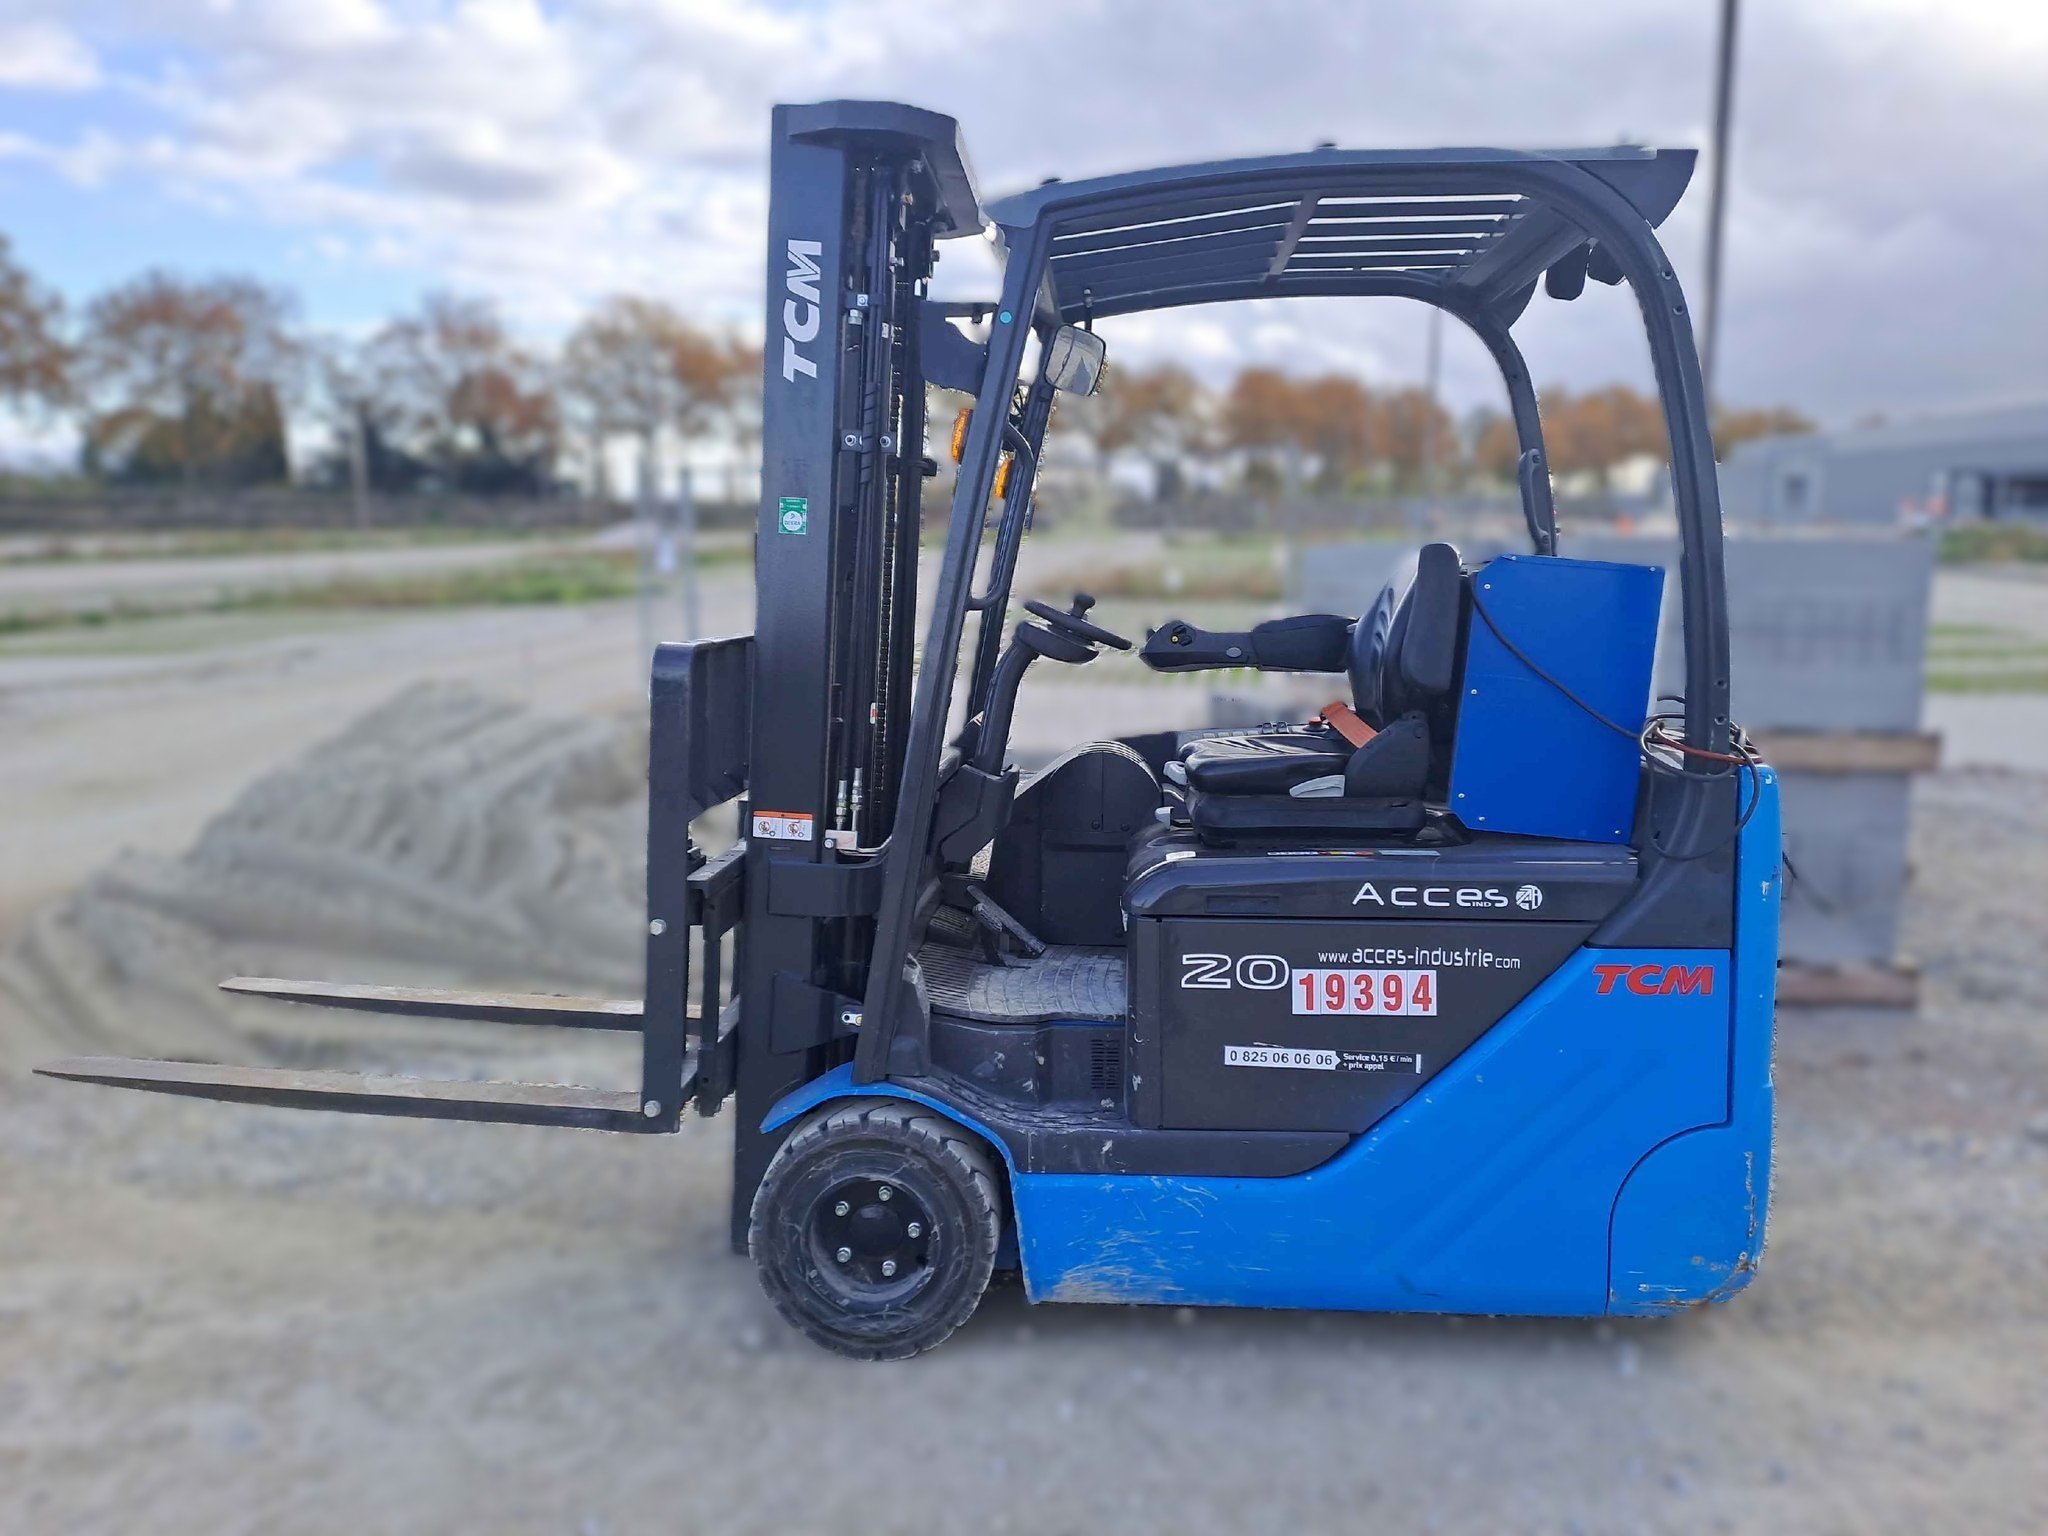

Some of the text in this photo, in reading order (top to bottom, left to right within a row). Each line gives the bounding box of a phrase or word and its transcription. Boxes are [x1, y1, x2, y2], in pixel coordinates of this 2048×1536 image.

[783, 239, 822, 383] TCM
[1352, 882, 1509, 908] Acces
[1181, 954, 1289, 990] 20
[1592, 964, 1714, 996] TCM
[1298, 973, 1433, 1012] 19394
[1230, 1050, 1333, 1066] 0 825 06 06 06
[1343, 1053, 1370, 1062] Service
[1348, 1062, 1363, 1070] prix
[1364, 1063, 1384, 1071] appel
